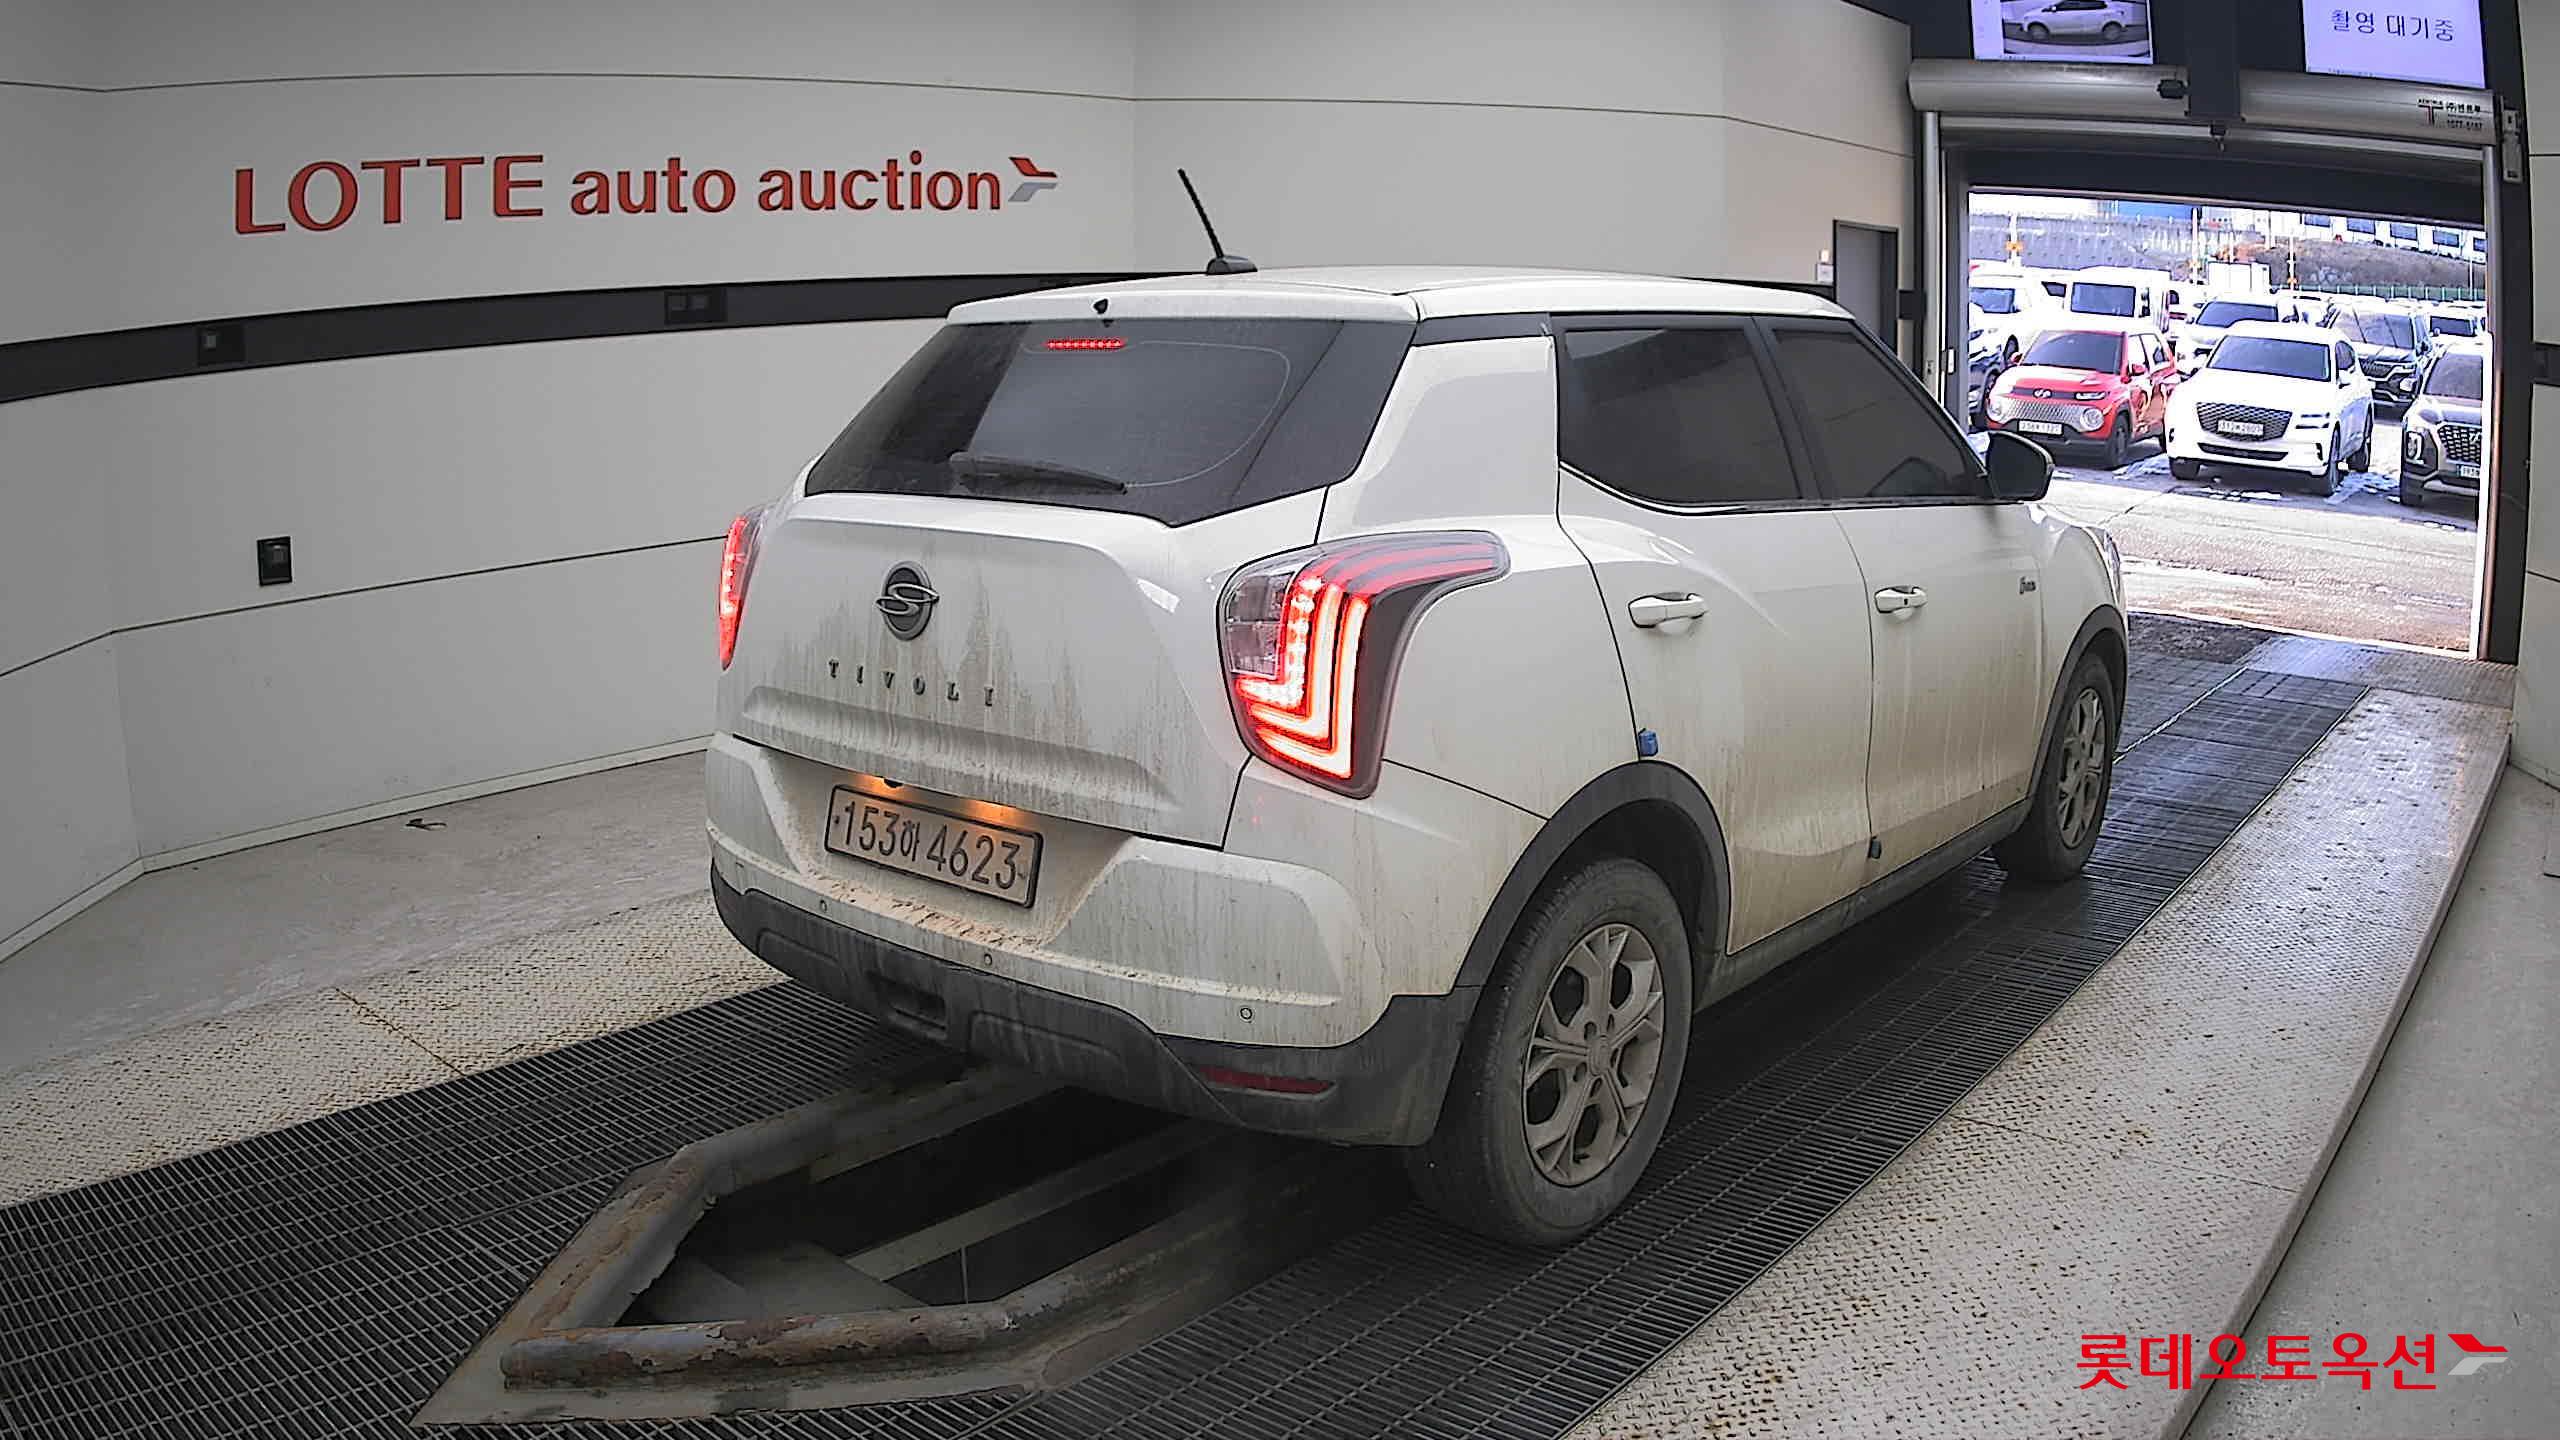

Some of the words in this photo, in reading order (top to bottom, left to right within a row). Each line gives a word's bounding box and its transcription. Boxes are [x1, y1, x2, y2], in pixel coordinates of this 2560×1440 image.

[2331, 9, 2376, 34] 촬영
[2386, 15, 2454, 42] 대기중
[234, 153, 545, 235] LOTTE
[569, 155, 737, 216] auto
[757, 149, 1002, 213] auction
[828, 658, 995, 708] TIVOLI
